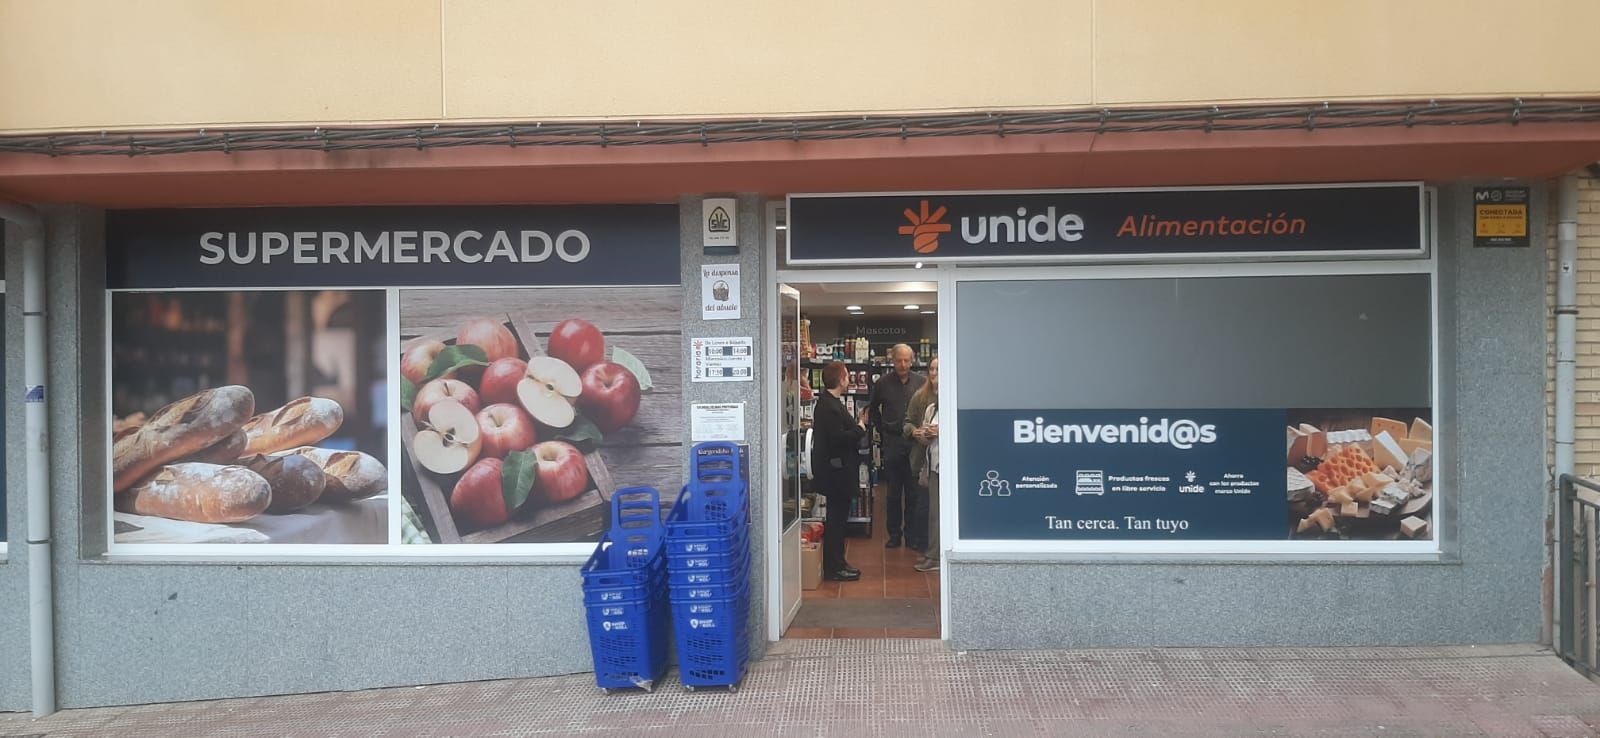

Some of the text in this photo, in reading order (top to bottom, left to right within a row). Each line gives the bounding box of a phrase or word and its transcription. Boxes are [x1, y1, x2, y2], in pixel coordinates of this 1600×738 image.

[961, 206, 1307, 244] unide Alimentación
[199, 229, 591, 265] SUPERMERCADO
[856, 326, 907, 335] Mascotas
[1013, 417, 1217, 449] Bienvenid@s
[1179, 484, 1205, 493] unide
[1045, 516, 1189, 533] Tan cerca. Tan tuyo
